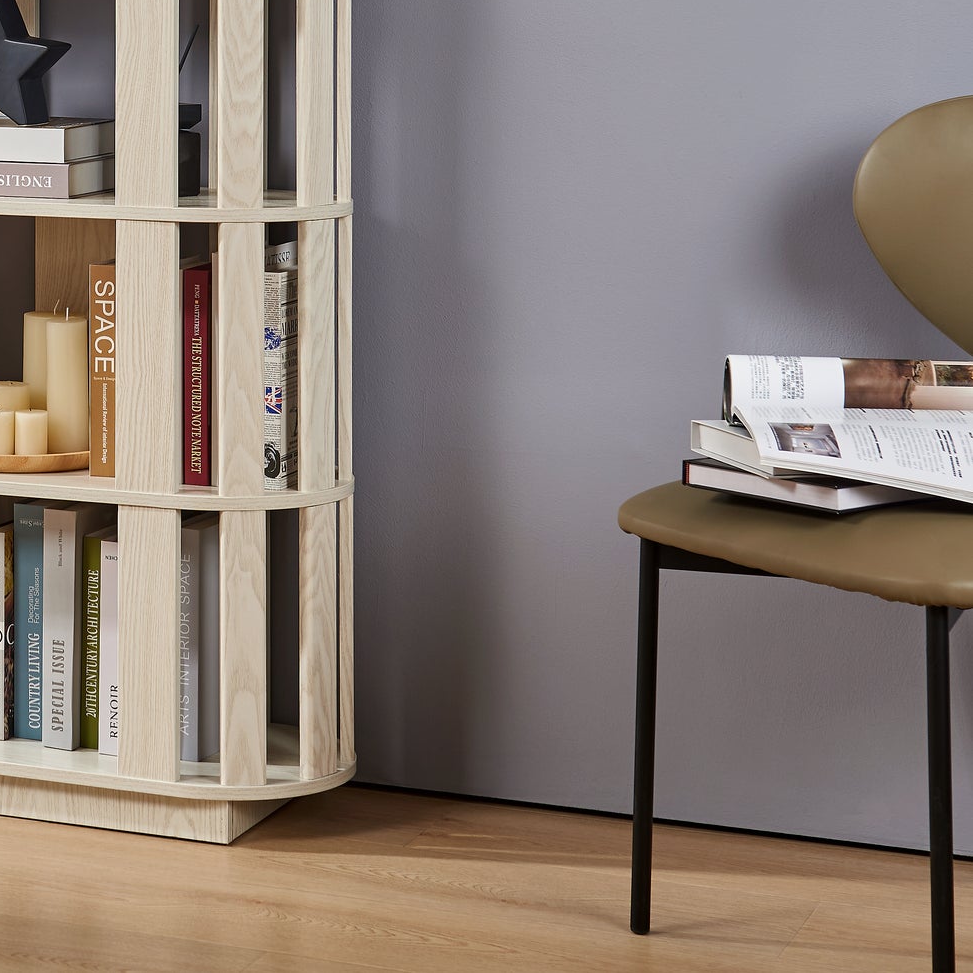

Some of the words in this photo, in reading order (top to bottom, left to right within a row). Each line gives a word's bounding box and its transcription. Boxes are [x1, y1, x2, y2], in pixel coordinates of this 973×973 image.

[94, 279, 115, 373] SPACE
[191, 336, 202, 354] THE
[191, 355, 202, 412] STRUCTURED
[191, 413, 202, 437] NOTE
[191, 438, 202, 474] NARKET
[180, 554, 191, 605] SPACE
[28, 633, 40, 672] LIVING
[52, 639, 65, 674] ISSUE
[180, 613, 190, 685] INTERIOR
[28, 673, 41, 729] COUNTRY
[51, 680, 64, 732] SPECIAL
[109, 685, 118, 739] RENOIR
[179, 695, 190, 736] ARTS
